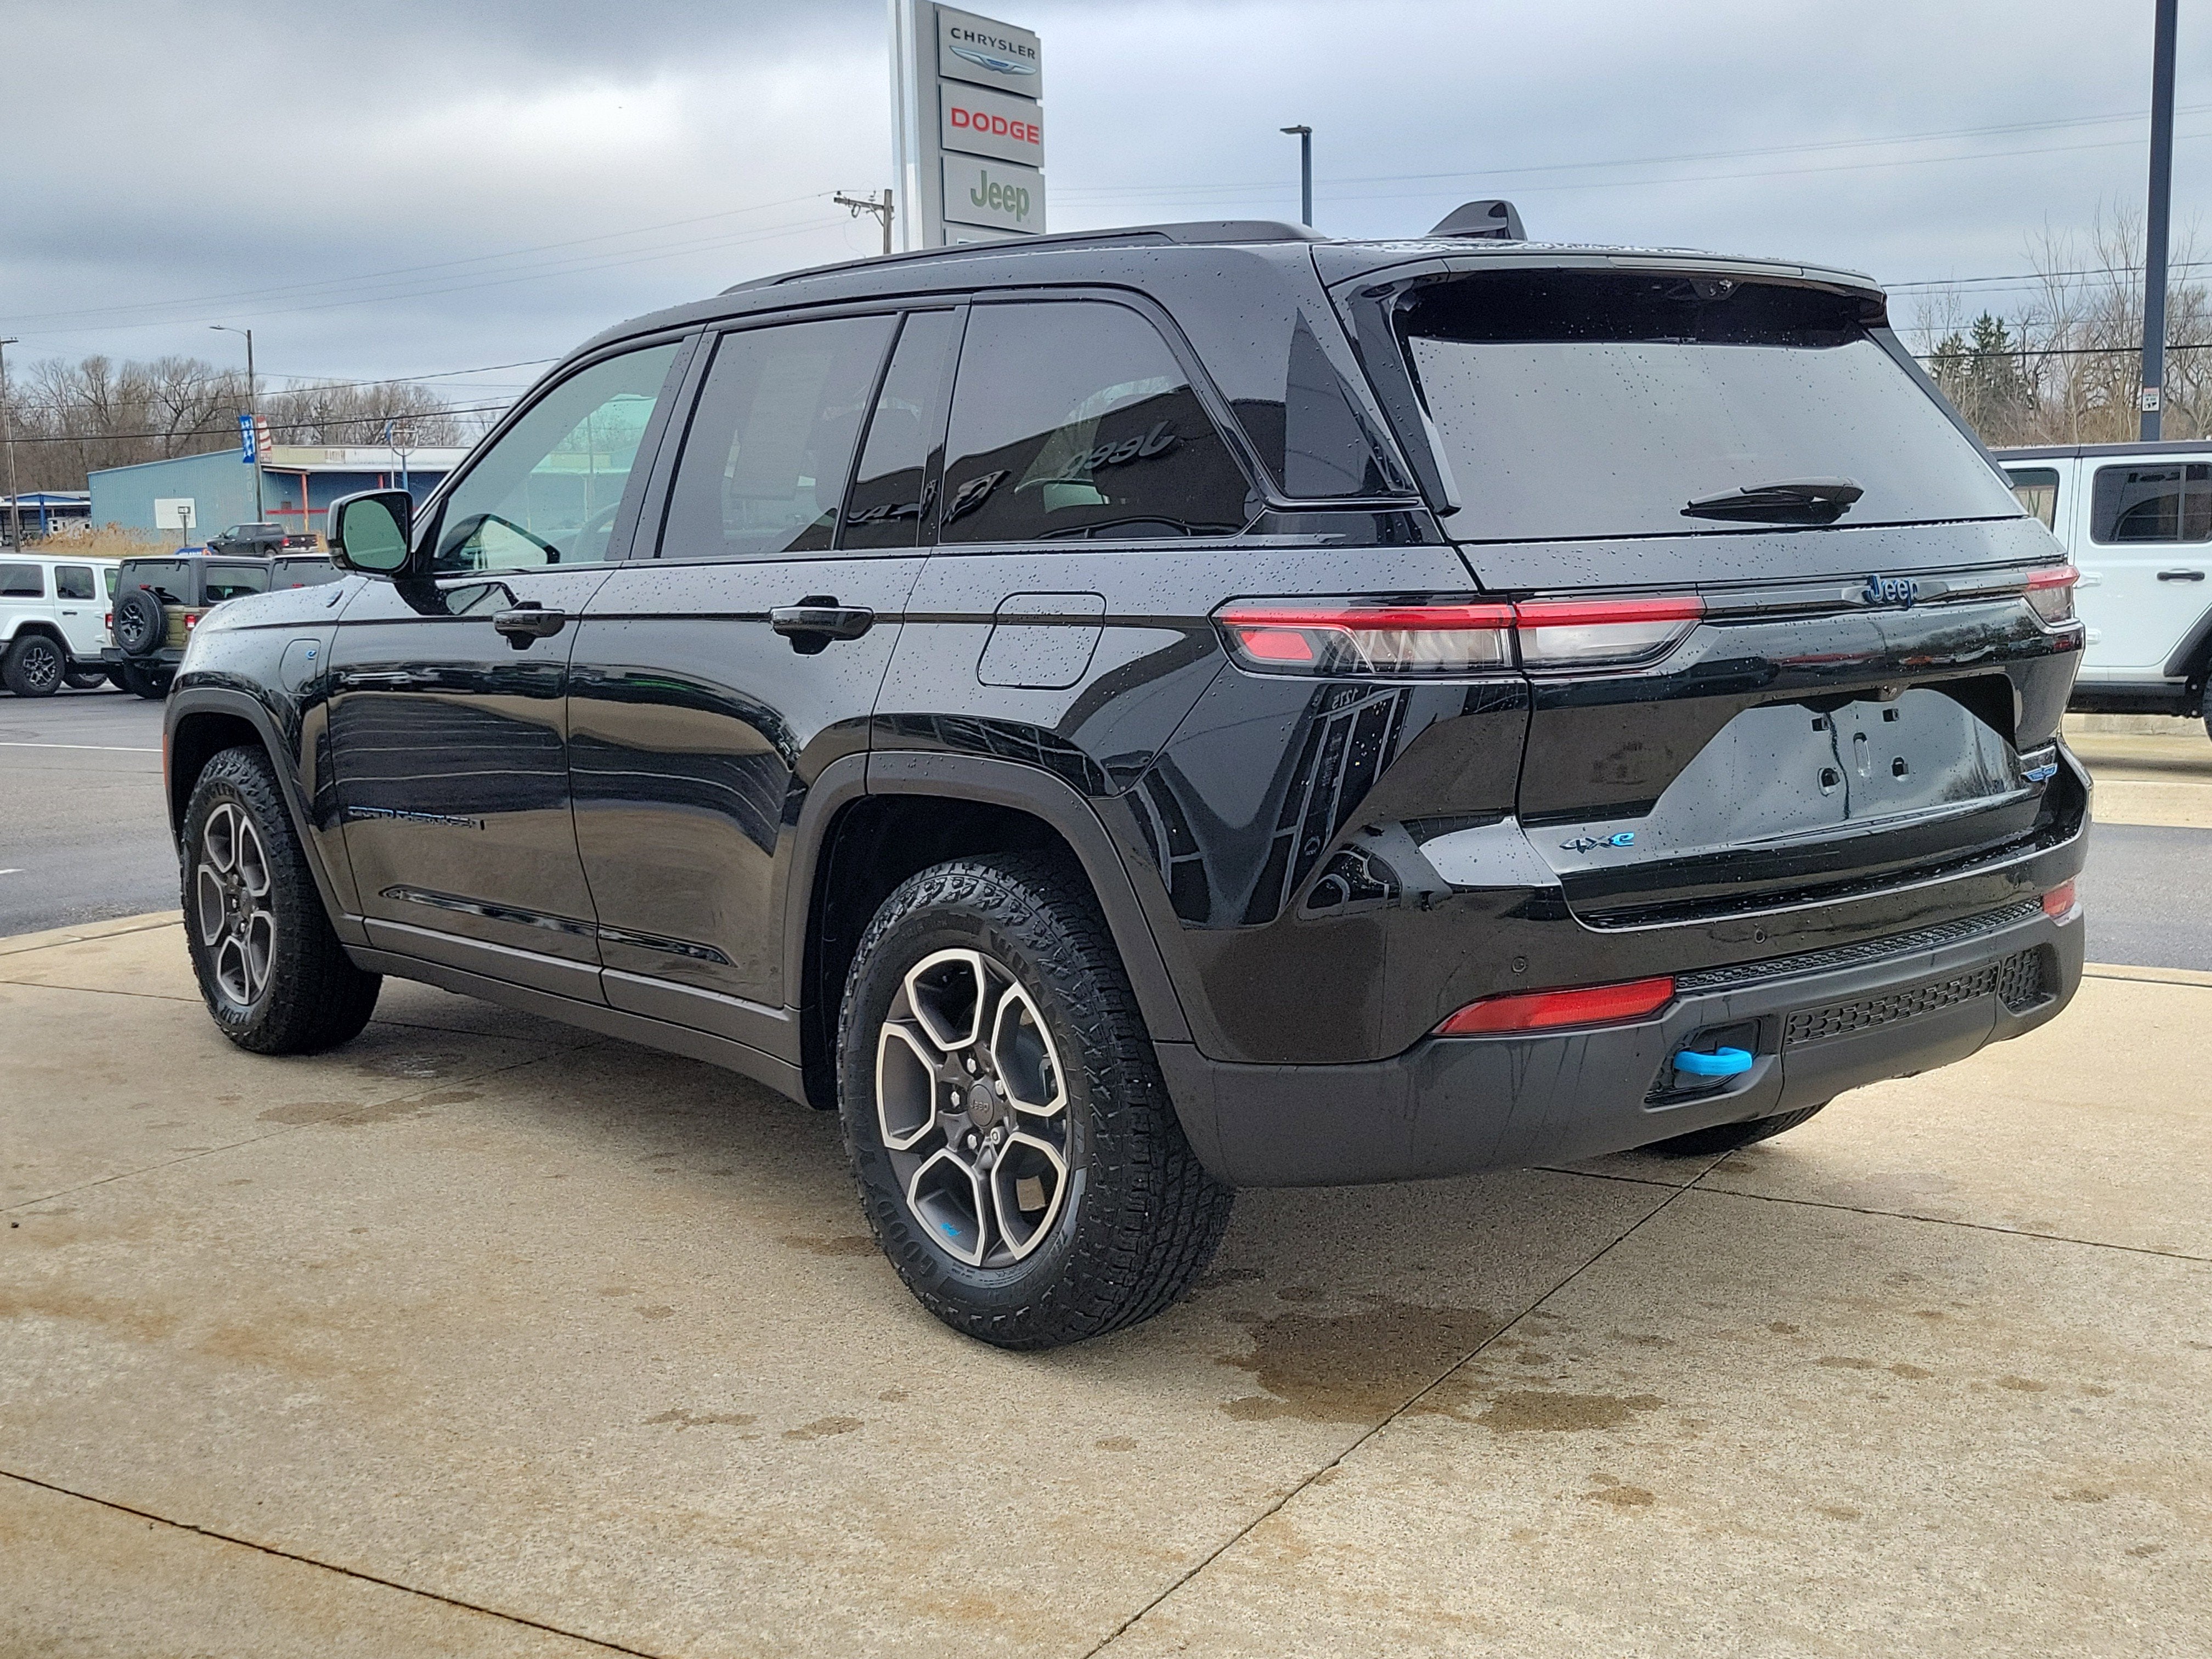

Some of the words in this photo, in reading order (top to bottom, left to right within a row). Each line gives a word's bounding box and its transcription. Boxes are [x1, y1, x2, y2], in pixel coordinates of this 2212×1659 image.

[951, 28, 1035, 59] CHRYSLER
[951, 108, 1039, 145] DODGE
[970, 170, 1030, 222] Jeep
[1863, 574, 1923, 607] Jeep
[969, 1099, 990, 1114] Jeep
